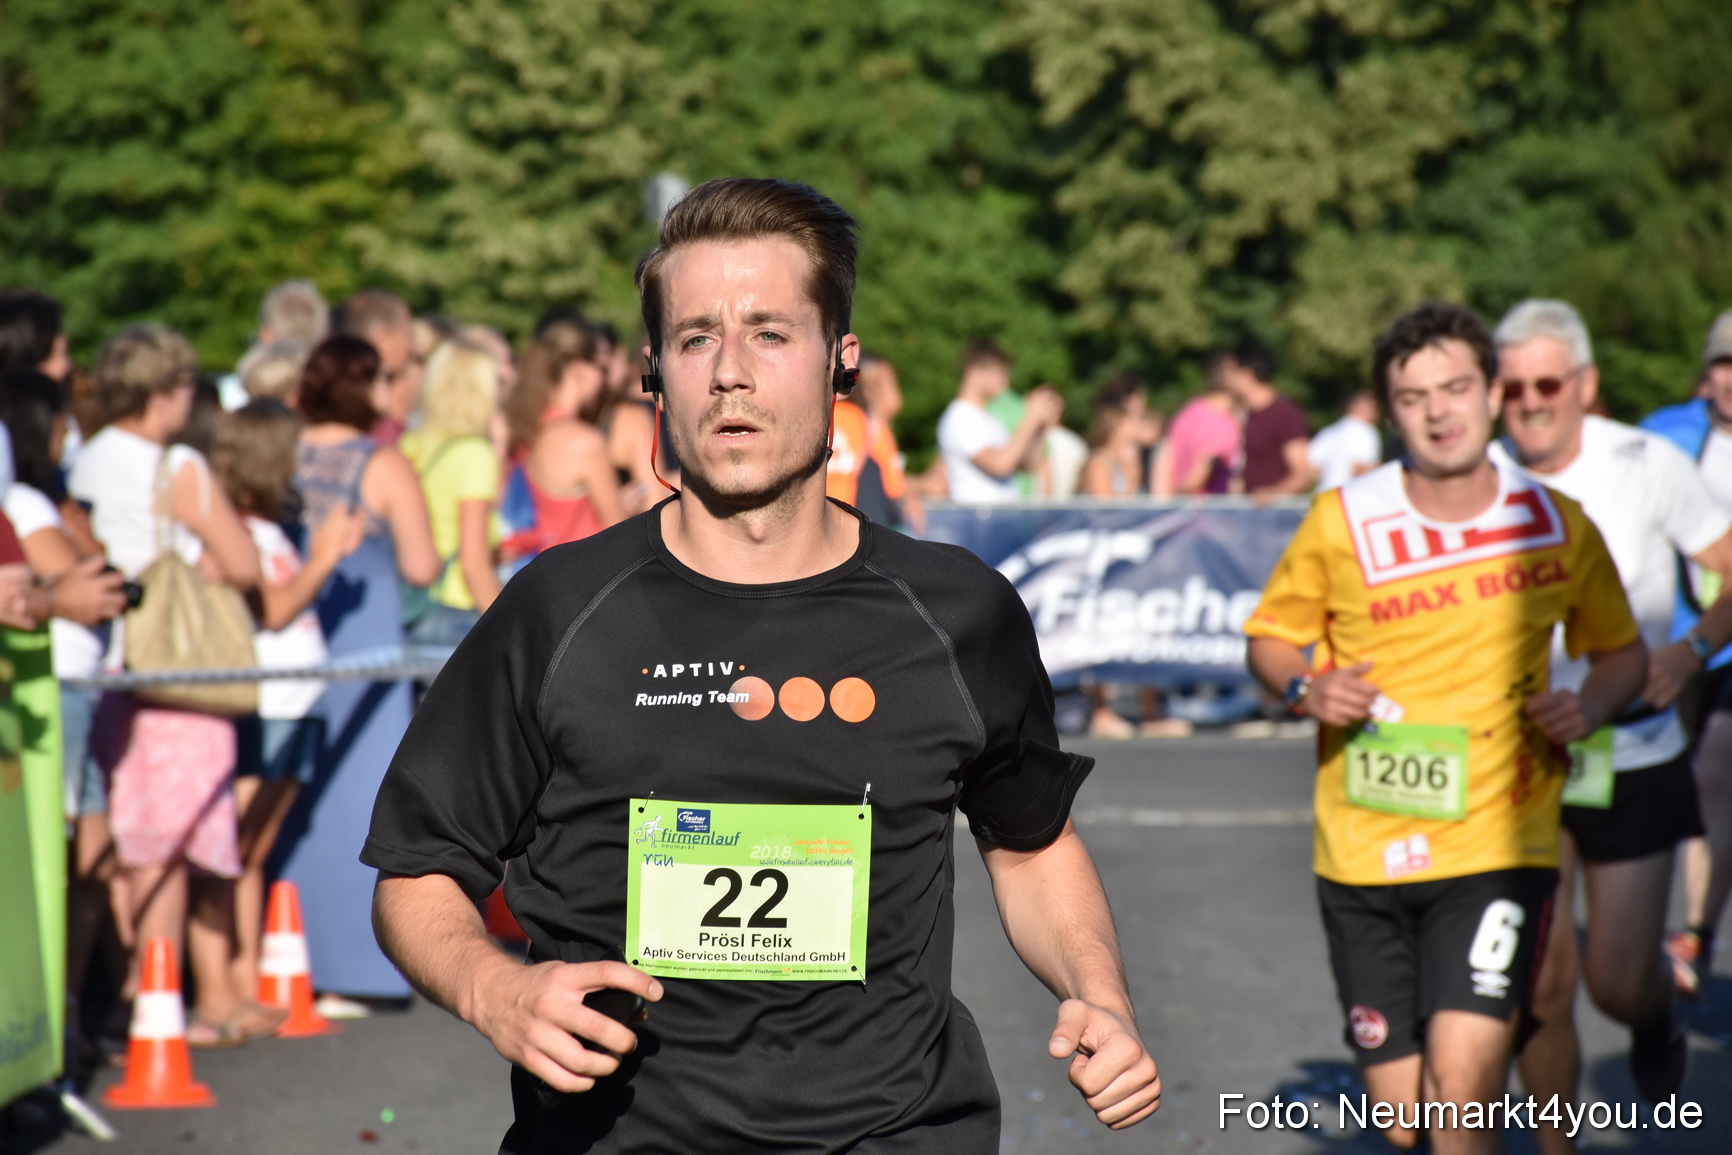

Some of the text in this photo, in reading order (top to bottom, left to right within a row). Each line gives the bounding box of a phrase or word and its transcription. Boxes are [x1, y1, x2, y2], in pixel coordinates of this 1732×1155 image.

[1369, 560, 1570, 625] MAX BÖGL
[1037, 576, 1258, 636] Fische
[653, 661, 734, 678] APTIV
[635, 690, 750, 707] Running Team
[1358, 752, 1448, 790] 1206
[661, 828, 741, 846] firmenlauf
[750, 845, 792, 859] 2018
[700, 868, 789, 928] 22
[698, 932, 792, 948] Prösl Felix
[1468, 898, 1525, 972] 6
[643, 946, 846, 962] Aptiv Services Deutschland GmbH
